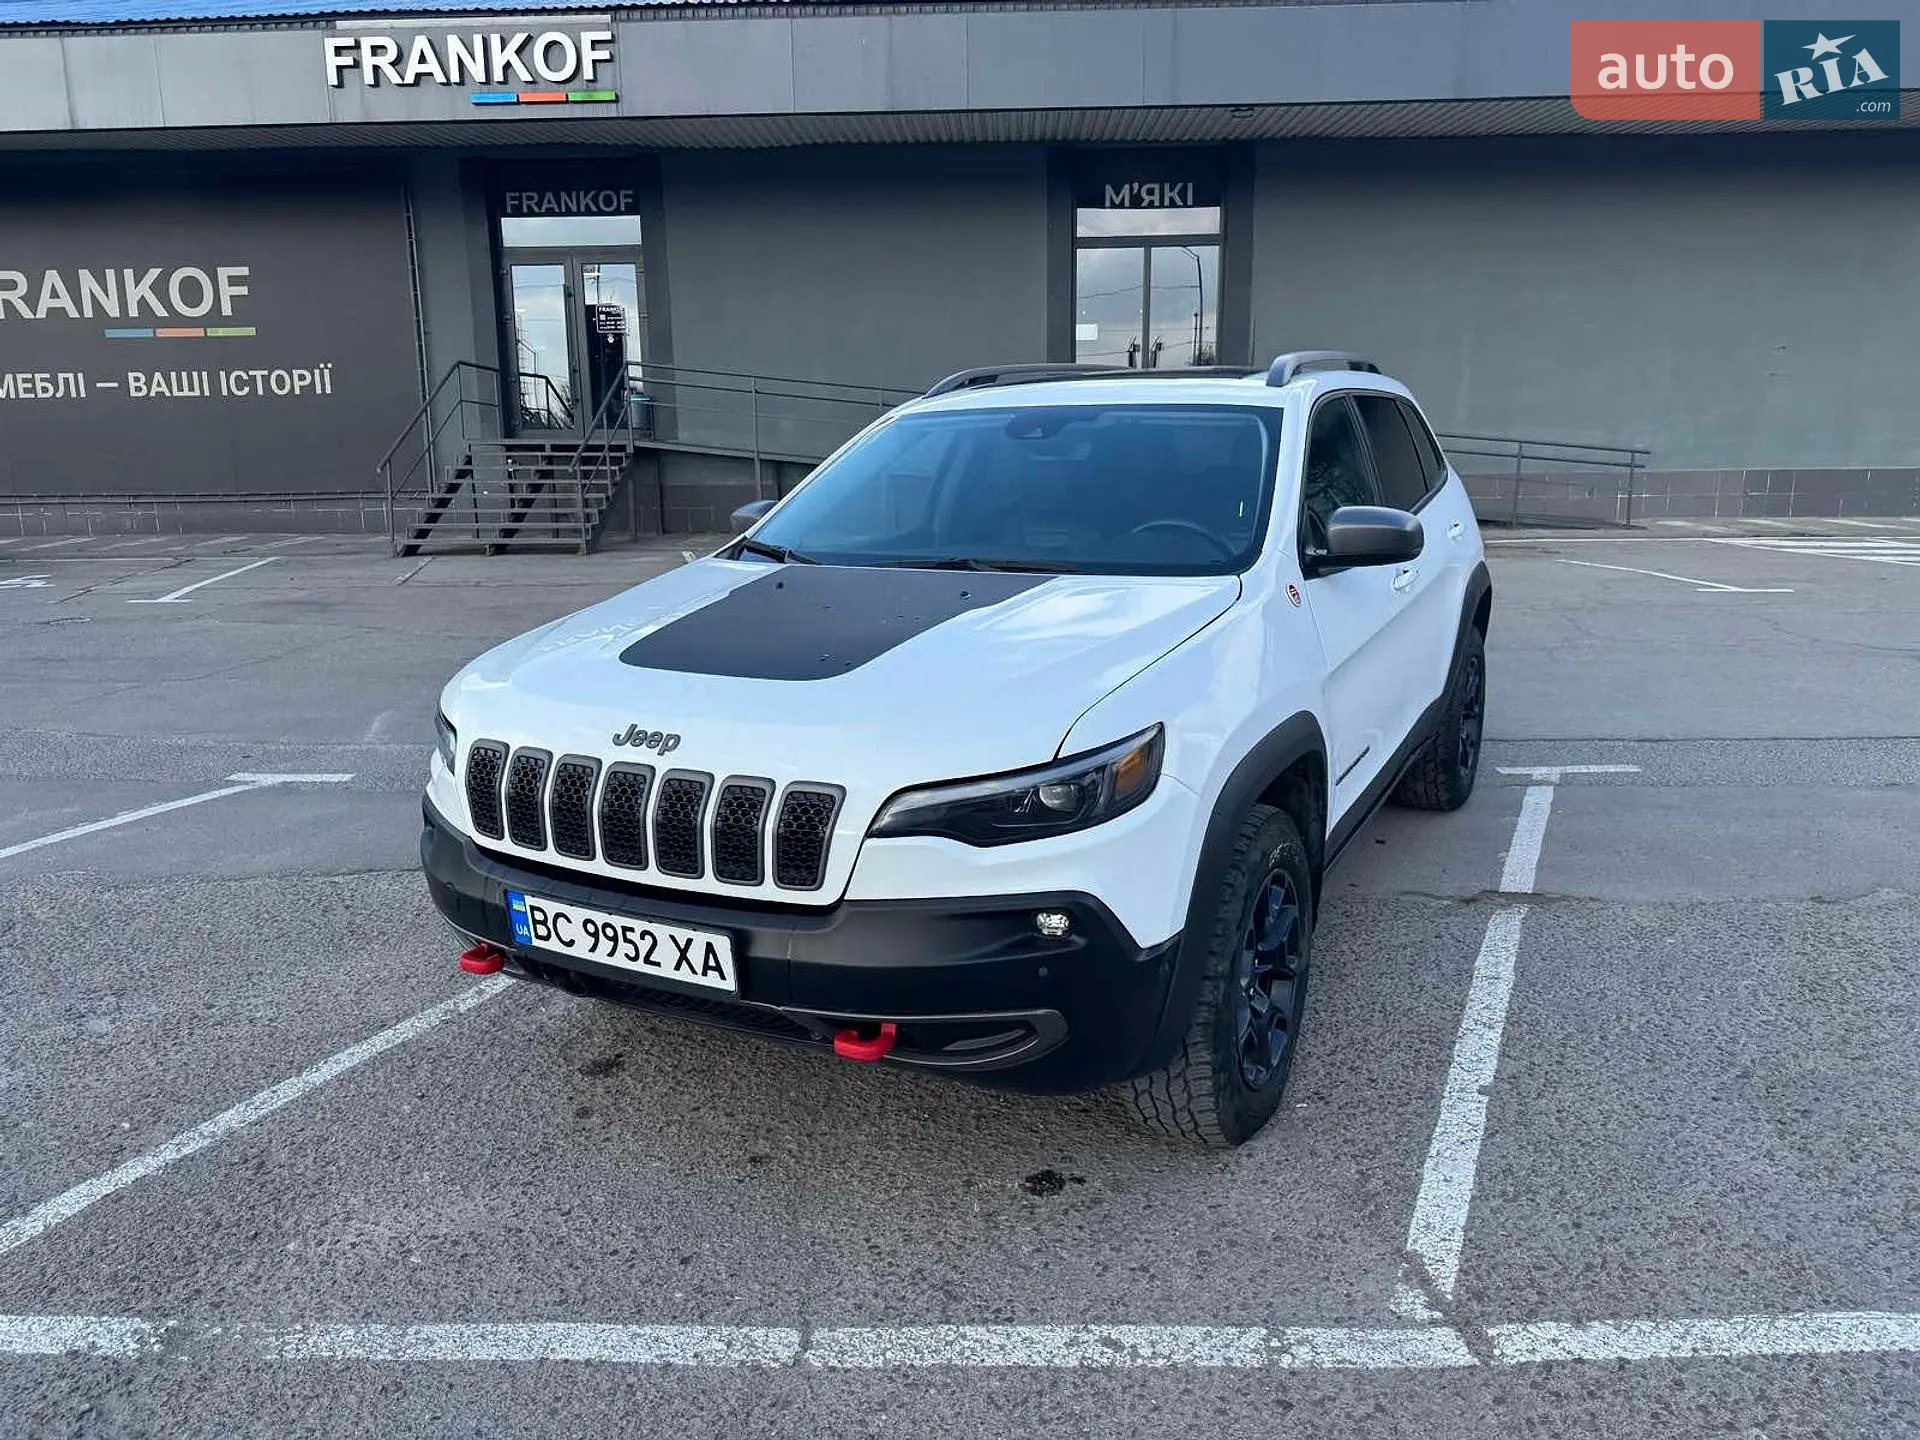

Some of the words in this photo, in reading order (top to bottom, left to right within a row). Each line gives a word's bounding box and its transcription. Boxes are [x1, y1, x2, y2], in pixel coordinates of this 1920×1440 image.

[324, 31, 613, 86] FRANKOF
[505, 190, 634, 213] FRANKOF
[128, 371, 211, 398] ВАШІ
[219, 362, 333, 397] ІСТОРІЇ
[612, 723, 681, 756] Jeep
[514, 924, 530, 937] UA
[529, 904, 576, 948] BC
[582, 917, 662, 968] 9952
[668, 933, 727, 981] XA
